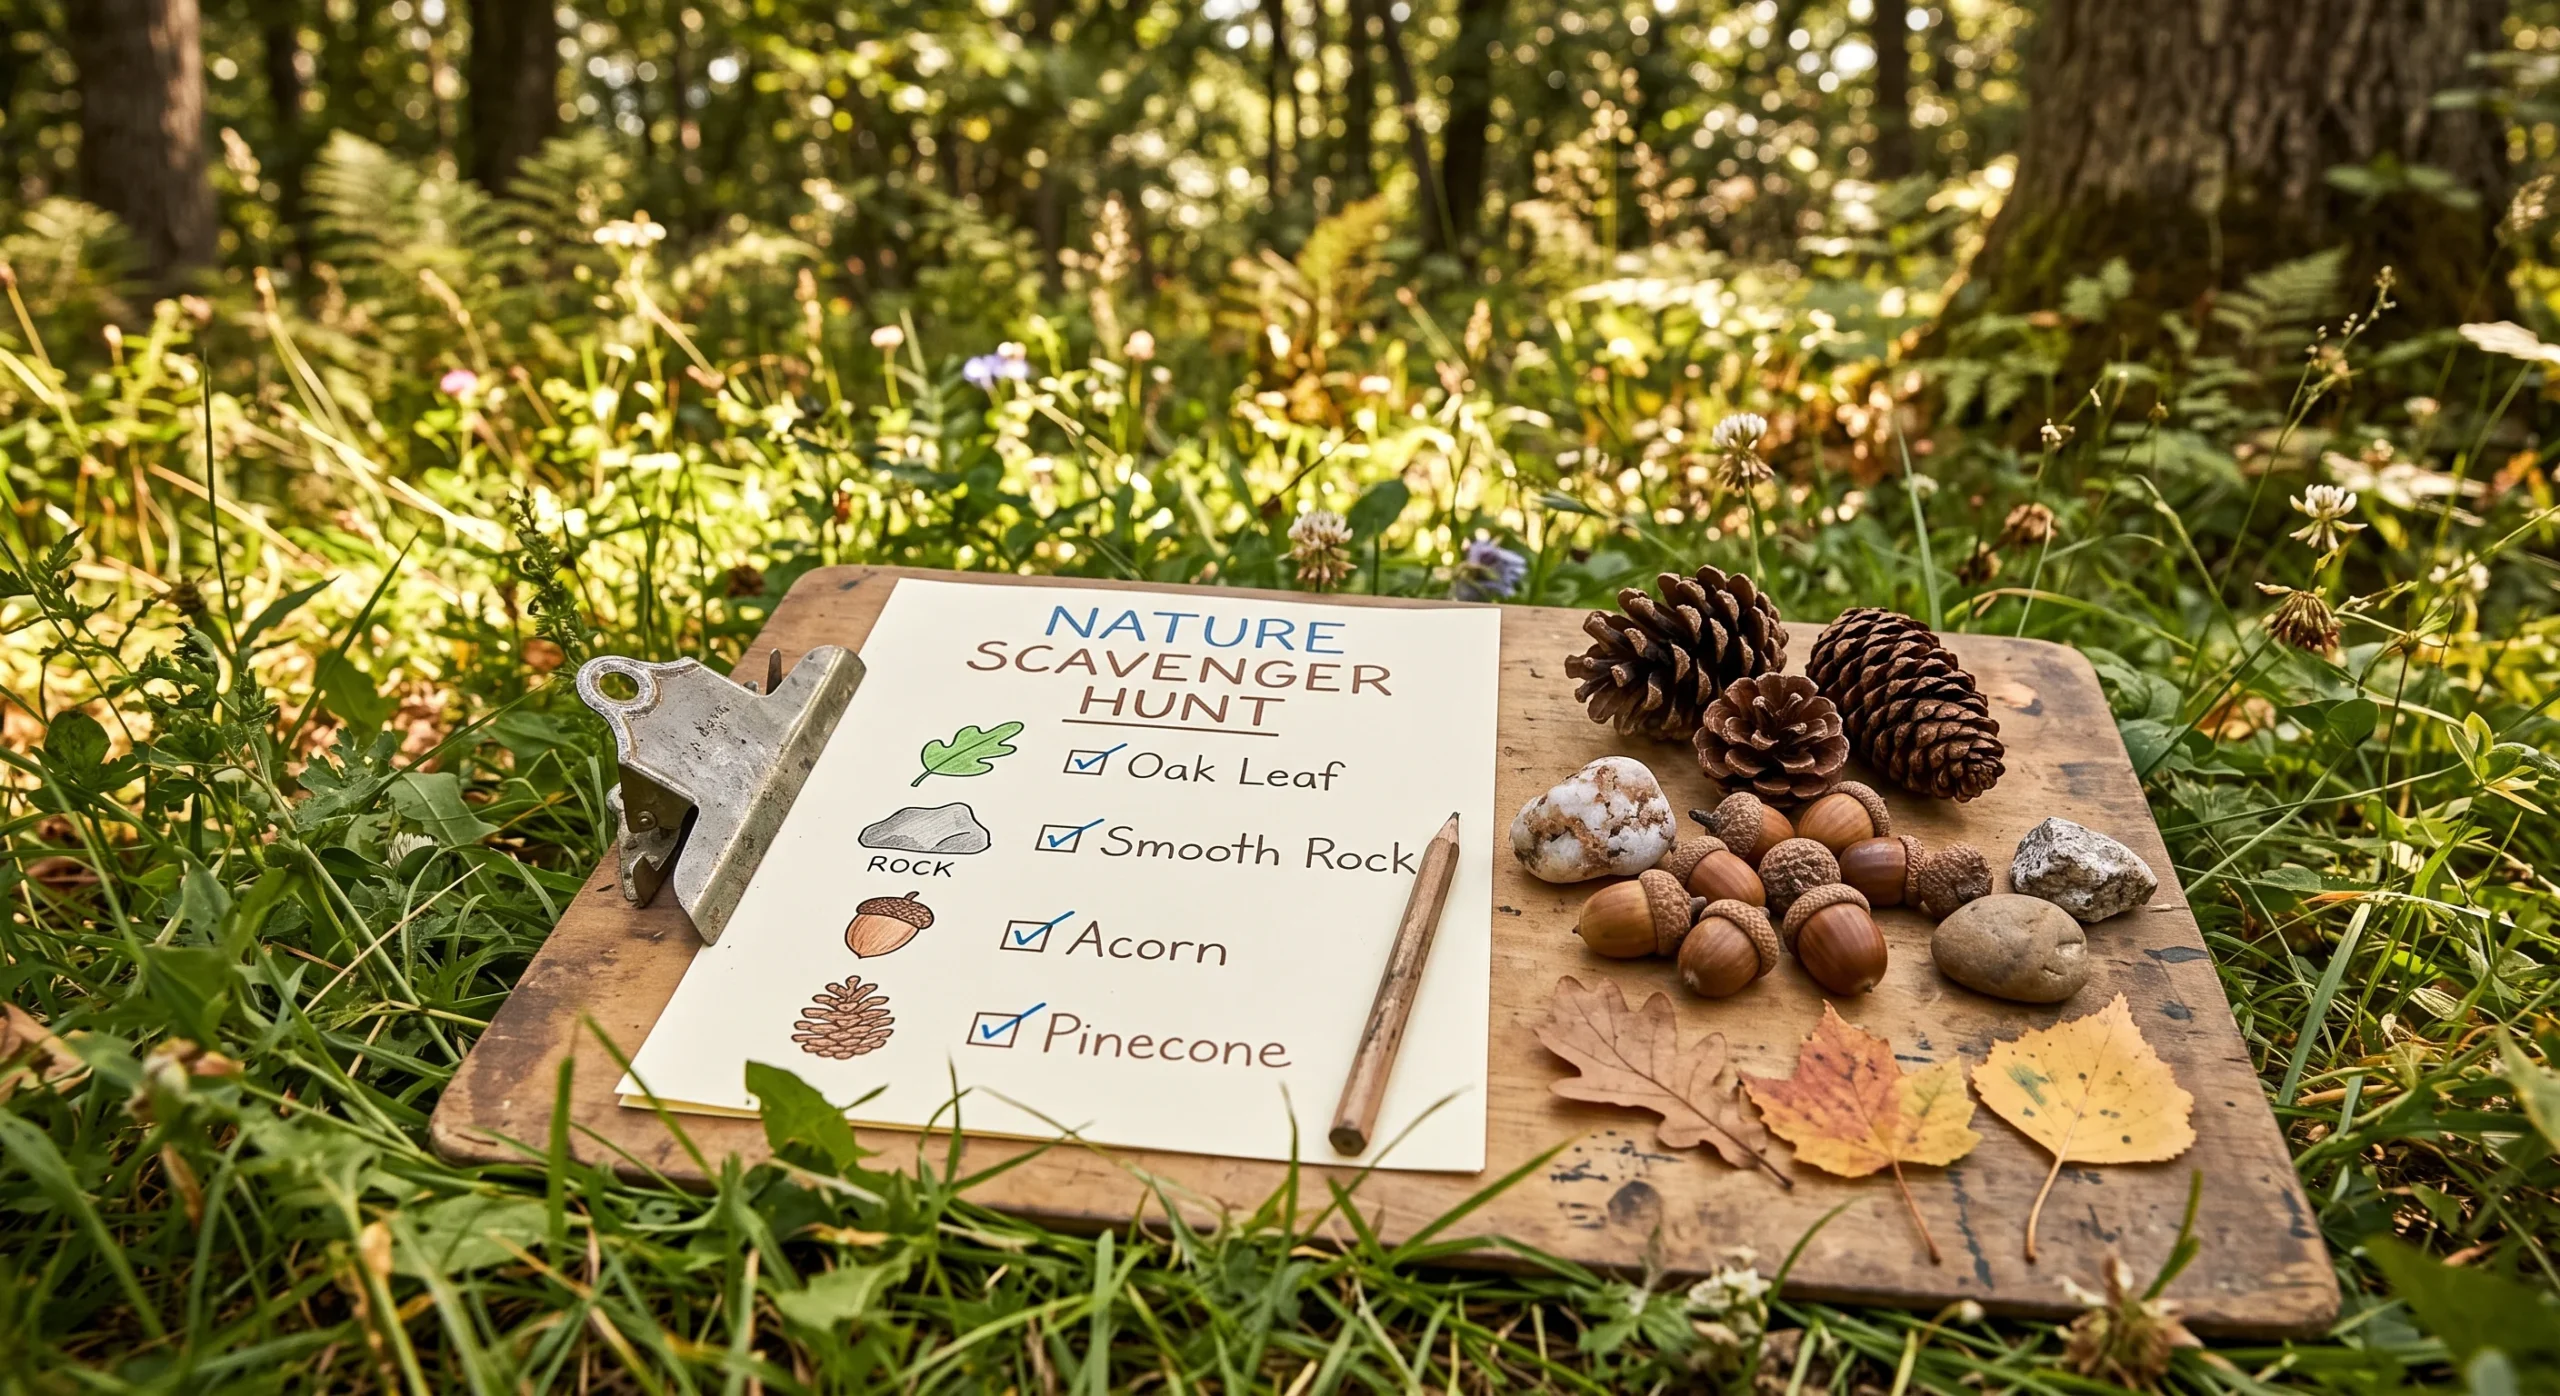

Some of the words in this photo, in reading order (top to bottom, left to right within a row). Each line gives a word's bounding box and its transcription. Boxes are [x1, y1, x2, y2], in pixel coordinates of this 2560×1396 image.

[1045, 606, 1345, 654] NATURE
[966, 641, 1392, 696] SCAVENGER
[1079, 685, 1285, 727] HUNT
[1127, 752, 1216, 783] Oak
[1239, 757, 1347, 791] Leaf
[866, 856, 955, 878] ROCK
[1100, 826, 1280, 867] Smooth
[1305, 836, 1417, 875] Rock
[1065, 919, 1227, 967] Acorn
[1043, 1012, 1292, 1069] Pinecone
